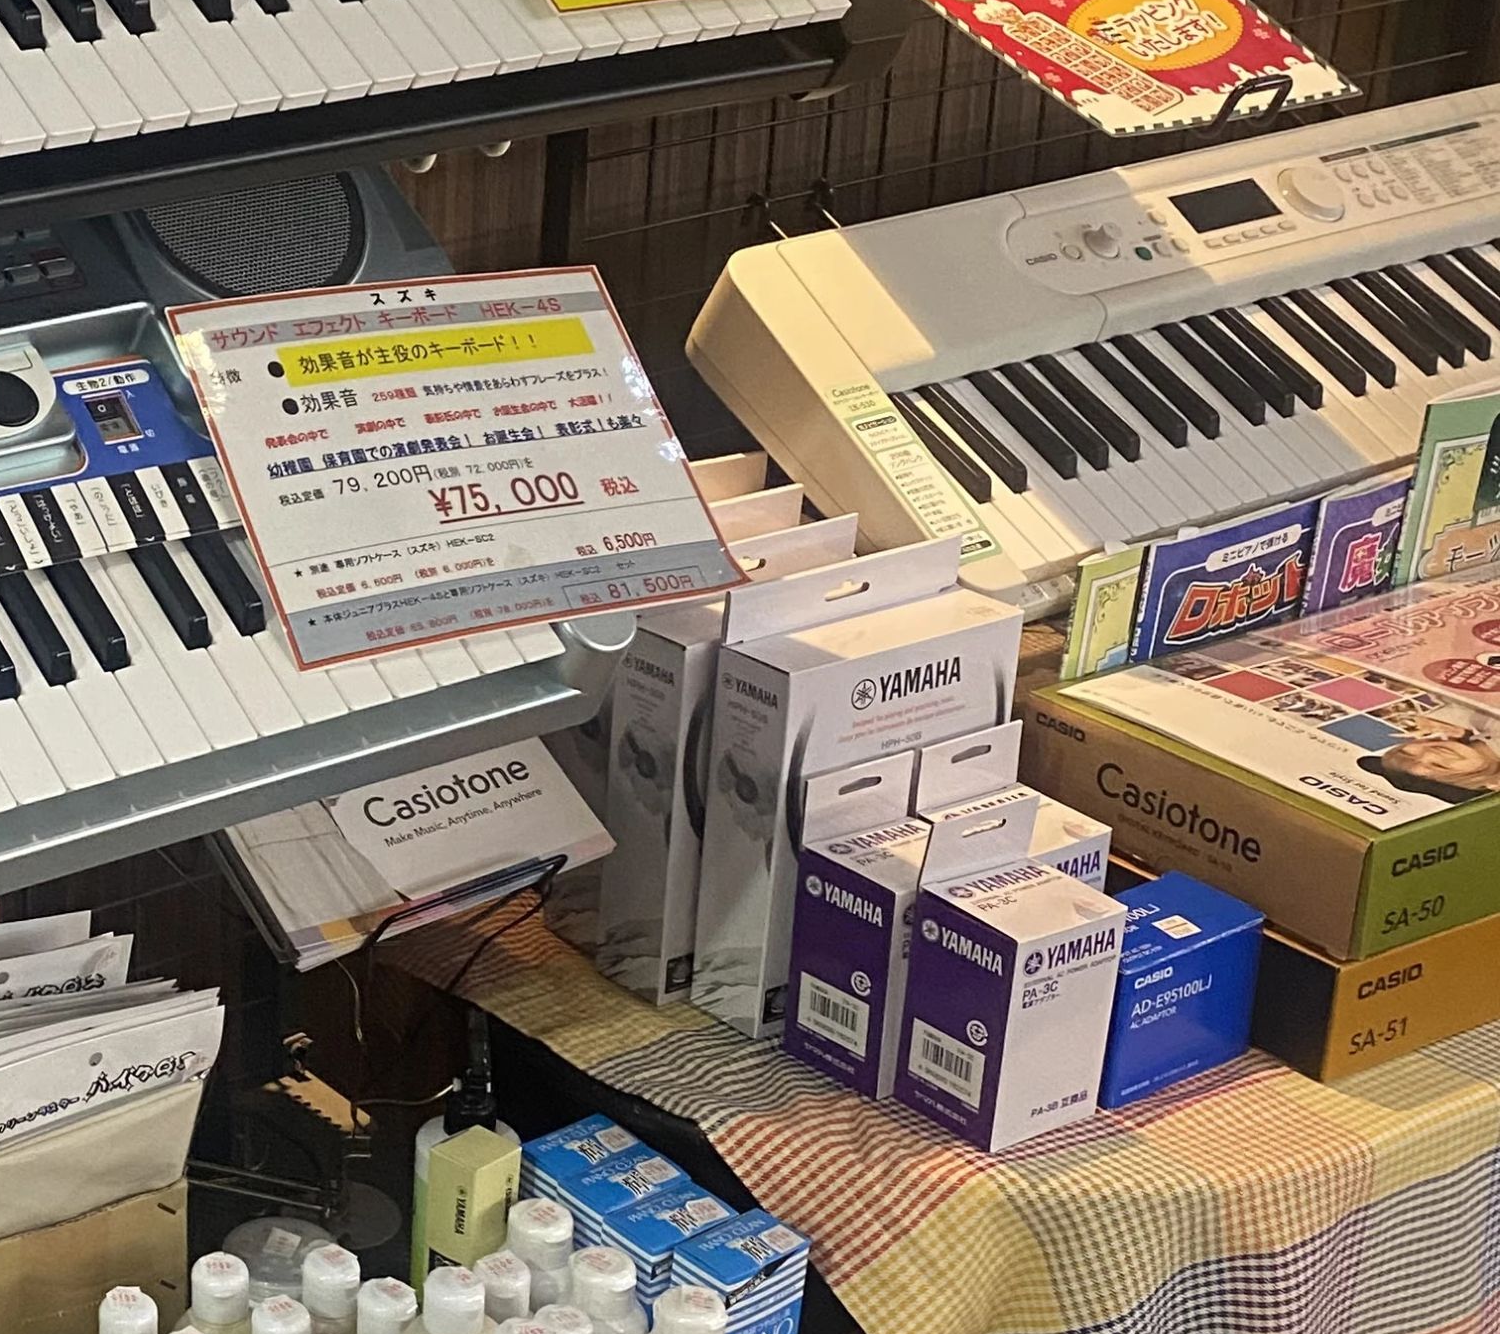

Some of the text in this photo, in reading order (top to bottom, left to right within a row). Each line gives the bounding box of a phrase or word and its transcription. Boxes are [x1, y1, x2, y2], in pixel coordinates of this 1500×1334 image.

[212, 304, 459, 350] サウンド エフェクト キーボード
[301, 388, 358, 415] 効果音
[267, 457, 314, 479] 幼稚園
[600, 475, 640, 497] 税込
[279, 489, 325, 506] 税込定価
[1165, 554, 1305, 645] ロボット
[634, 658, 675, 687] YAMAHA
[879, 655, 962, 704] YAMAHA
[734, 678, 779, 710] YAMAHA
[1035, 710, 1087, 744] CASIO
[363, 754, 531, 829] Casiotone
[1299, 775, 1389, 816] CASIO
[383, 786, 544, 848] Make Music, Anytime, Anywhere
[1096, 761, 1262, 865] Casiotone
[847, 821, 928, 851] YAMAHA
[1390, 841, 1459, 878] CASIO
[964, 863, 1051, 896] YAMAHA
[824, 880, 884, 929] YAMAHA
[1381, 895, 1445, 936] SA-50
[941, 926, 1004, 977] YAMAHA
[1047, 928, 1116, 970] YAMAHA
[1022, 980, 1059, 1002] PA-3C
[1131, 974, 1212, 1017] AD-E95100LJ
[1134, 966, 1173, 989] CASIO
[1358, 963, 1423, 1001] CASIO
[1348, 1016, 1409, 1056] SA-51
